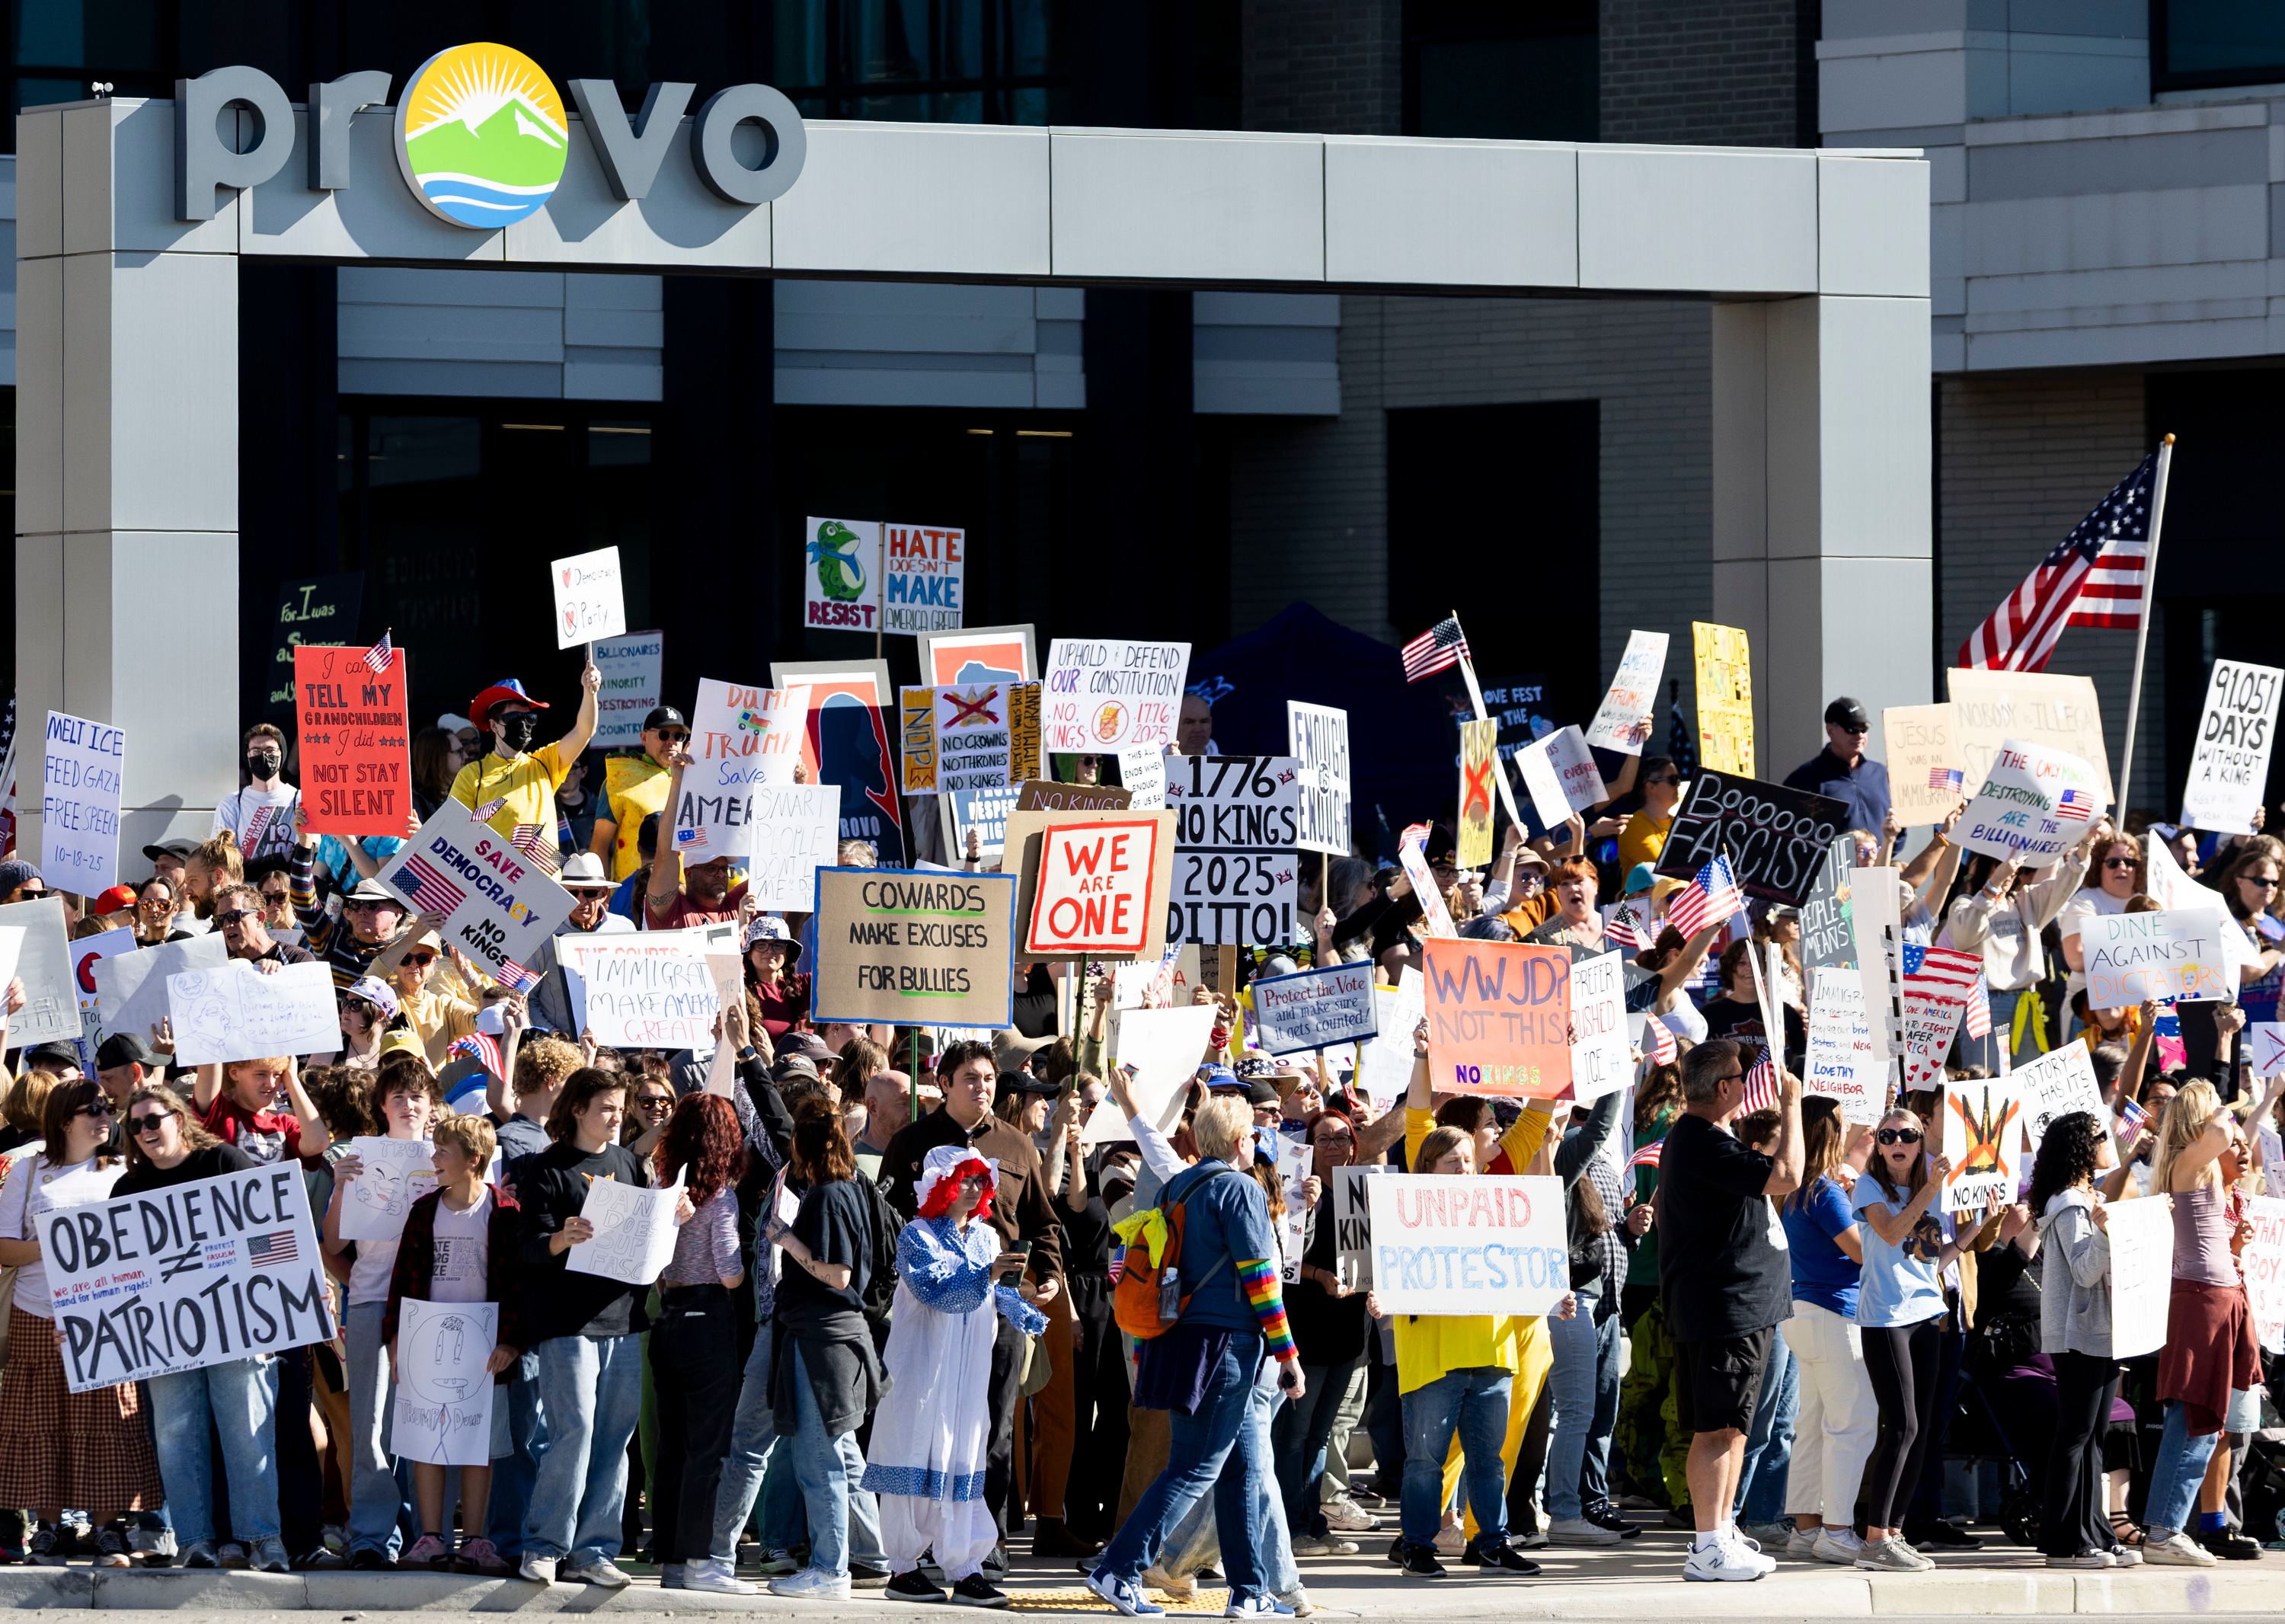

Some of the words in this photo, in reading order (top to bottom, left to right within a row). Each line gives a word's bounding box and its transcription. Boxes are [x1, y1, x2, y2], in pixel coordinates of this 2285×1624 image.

[890, 529, 962, 562] HATE
[890, 558, 952, 575] DOESN'T
[888, 573, 960, 609] MAKE
[580, 599, 609, 631] Party
[809, 600, 877, 628] RESIST
[885, 607, 928, 631] AMERICA
[597, 643, 660, 659] BILLIONAIRES
[1058, 643, 1107, 668] UPHOLD
[1124, 644, 1181, 670] DEFEND
[305, 683, 348, 708] TELL
[362, 683, 392, 707] MY
[1051, 668, 1080, 694] OUR
[1089, 670, 1181, 697] CONSTITUTION
[1511, 685, 1542, 704] FEST
[726, 685, 794, 711] DUMP
[1053, 702, 1076, 723] NO
[1608, 688, 1645, 710] TRUMP
[304, 711, 403, 727] GRANDCHILDREN
[1024, 680, 1041, 765] IMMIGRANTS
[1136, 702, 1170, 724] 1776
[1503, 707, 1529, 727] THE
[1957, 701, 2018, 729] NOBODY
[2029, 702, 2102, 735] ILLEGAL
[46, 714, 85, 746] MELT
[88, 727, 124, 757] ICE
[353, 730, 375, 748] did
[599, 721, 643, 736] COUNTRY
[942, 734, 963, 750] NO
[964, 731, 1008, 750] CROWNS
[1130, 724, 1168, 745] 2025
[1892, 720, 1946, 750] JESUS
[2204, 709, 2269, 751] DAYS
[704, 730, 794, 759] TRUMP
[1127, 750, 1142, 762] THIS
[1144, 747, 1155, 757] ALL
[1295, 711, 1348, 783] ENOUGH
[2197, 744, 2263, 771] WITHOUT
[312, 763, 349, 784] NOT
[356, 762, 399, 784] STAY
[942, 756, 961, 772] NO
[960, 753, 1008, 770] THRONES
[1124, 766, 1143, 779] ENDS
[1144, 761, 1163, 773] WHEN
[2002, 749, 2029, 771] THE
[45, 755, 81, 788] FEED
[83, 766, 120, 795] GAZA
[946, 776, 964, 791] NO
[968, 772, 1005, 788] KINGS
[1132, 778, 1158, 793] ENOUGH
[1187, 756, 1278, 798] 1776
[2201, 766, 2212, 783] A
[2219, 766, 2251, 786] KING
[319, 788, 395, 816] SILENT
[1031, 790, 1063, 810] NO
[1067, 794, 1127, 810] KINGS
[1132, 800, 1141, 809] OF
[1143, 796, 1152, 806] US
[1153, 792, 1164, 803] SAY
[1980, 778, 2053, 812] DESTROYING
[43, 797, 79, 831] FREE
[83, 807, 118, 838] SPEECH
[1166, 804, 1205, 845] NO
[1213, 804, 1298, 846] KINGS
[1299, 784, 1350, 852] ENOUGH
[1996, 810, 2031, 828] ARE
[2039, 818, 2062, 834] THE
[756, 823, 825, 856] PEOPLE
[1970, 823, 2067, 854] BILLIONAIRES
[55, 845, 102, 871] 10-18-25
[474, 839, 526, 886] SAVE
[1063, 833, 1130, 877] WE
[1655, 814, 1828, 901] FASCIST
[429, 836, 540, 929] DEMOCRACY
[1079, 874, 1115, 894] ARE
[1184, 855, 1276, 897] 2025
[862, 881, 986, 913] COWARDS
[1048, 893, 1133, 939] ONE
[1166, 901, 1291, 945] DITTO!
[1799, 900, 1839, 935] PEOPLE
[2107, 909, 2171, 941] DINÉ
[478, 918, 507, 944] NO
[849, 921, 900, 946] MAKE
[907, 922, 989, 948] EXCUSES
[1803, 921, 1850, 961] MEANS
[459, 923, 510, 969] KINGS
[2090, 938, 2207, 973] AGAINST
[858, 964, 896, 991] FOR
[900, 965, 972, 993] BULLIES
[1264, 986, 1314, 1008] Protect
[1316, 981, 1335, 997] the
[1334, 974, 1366, 995] Vote
[1574, 961, 1615, 1001] PREFER
[2092, 964, 2226, 1002] DICTATORS
[590, 992, 661, 1018] MAKE
[1275, 1005, 1296, 1022] and
[1300, 1001, 1330, 1018] make
[1334, 996, 1359, 1011] sure
[1922, 1005, 1953, 1021] AMERICA
[1274, 1025, 1284, 1041] it
[1286, 1021, 1311, 1042] gets
[1315, 1007, 1371, 1033] counted!
[1434, 1010, 1494, 1046] NOT
[1911, 1020, 1920, 1030] TO
[1922, 1021, 1955, 1037] FIGHT
[1584, 1048, 1606, 1086] ICE
[1813, 1061, 1836, 1077] LOVE
[1836, 1065, 1855, 1080] THY
[1808, 1079, 1865, 1096] NEIGHBOR
[2039, 1080, 2065, 1105] HAS
[2066, 1069, 2090, 1094] ITS
[1396, 1187, 1532, 1229] UNPAID
[1952, 1185, 1971, 1207] NO
[50, 1171, 296, 1274] OBEDIENCE
[204, 1239, 236, 1253] PROTEST
[451, 1252, 482, 1265] LAKE
[452, 1240, 481, 1254] SALT
[450, 1264, 481, 1277] CITY
[1378, 1242, 1568, 1290] PROTESTOR
[53, 1285, 69, 1300] we
[72, 1280, 91, 1294] are
[94, 1275, 107, 1288] all
[110, 1268, 145, 1284] human
[53, 1295, 78, 1309] stand
[78, 1291, 91, 1304] for
[92, 1285, 122, 1301] human
[123, 1277, 154, 1296] rights!
[62, 1268, 334, 1384] PATRIOTISM
[395, 1396, 440, 1432] TRUMP
